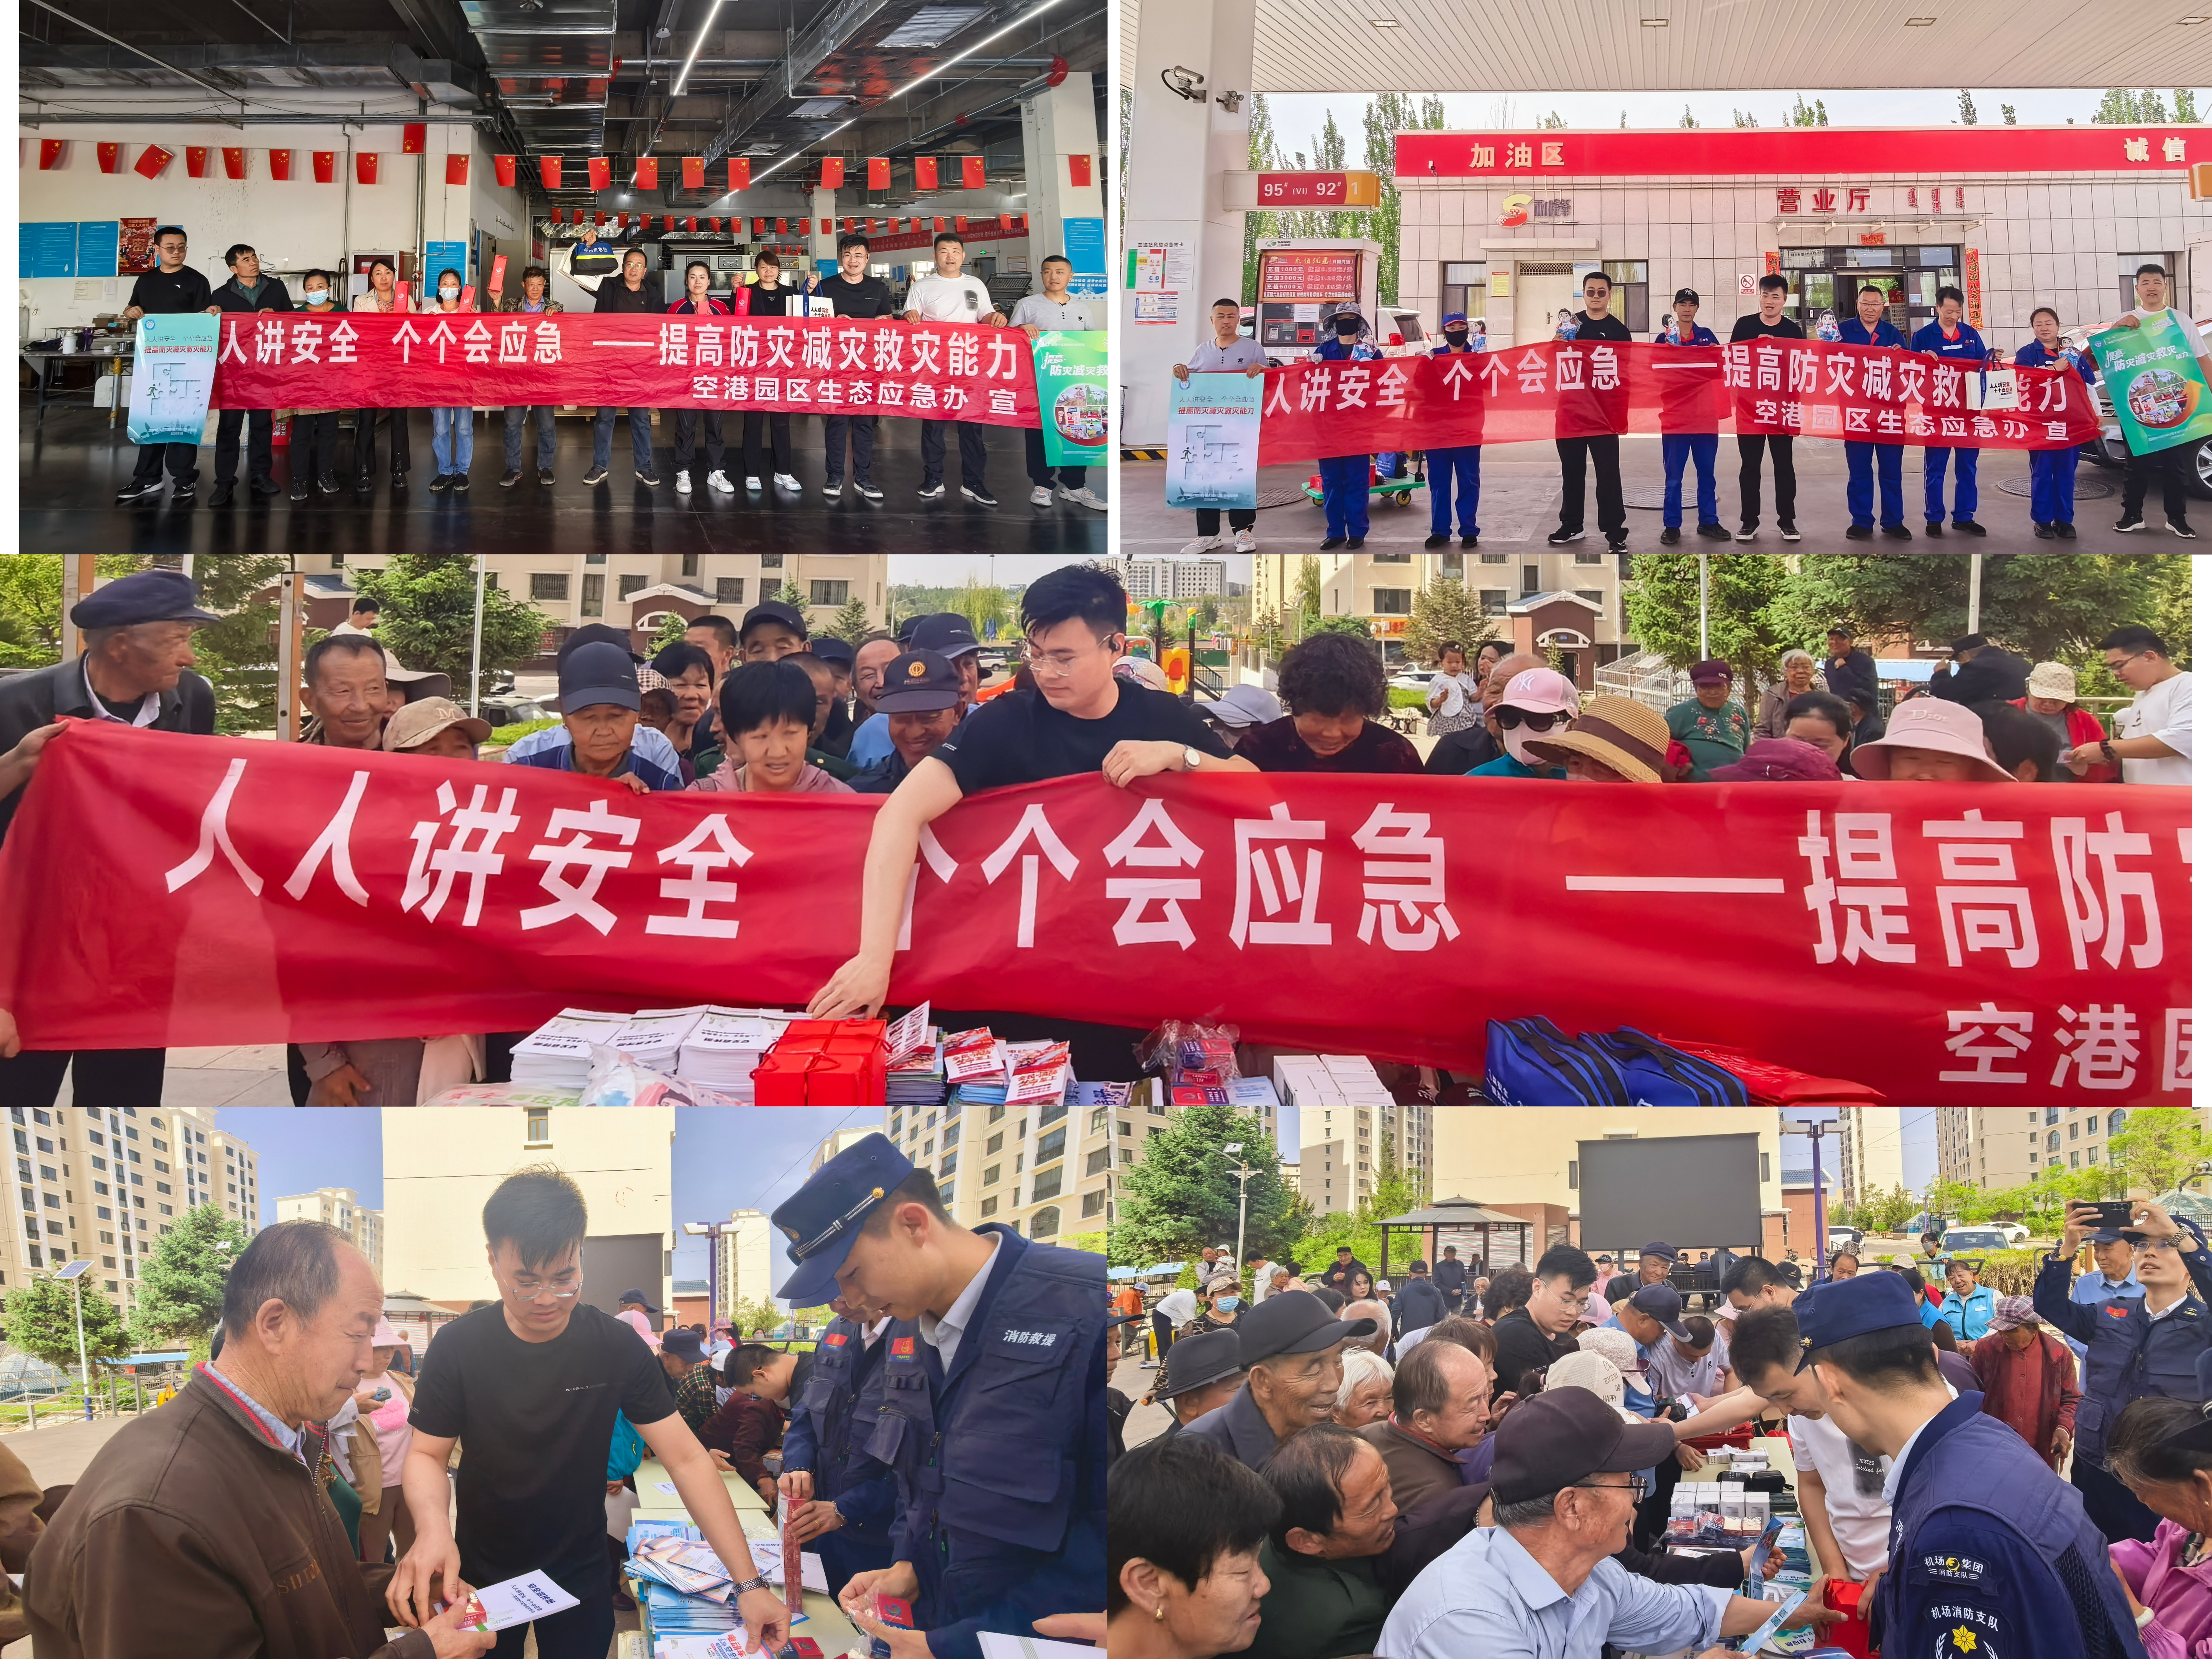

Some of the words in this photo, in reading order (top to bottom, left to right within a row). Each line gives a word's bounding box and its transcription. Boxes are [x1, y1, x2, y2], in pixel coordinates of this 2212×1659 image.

[1469, 142, 1564, 168] 加油区
[2124, 137, 2186, 162] 诚信
[1351, 182, 1358, 195] 1
[1777, 187, 1871, 213] 营业厅
[392, 319, 562, 364] 个个会应急
[1041, 352, 1067, 369] 提高
[2105, 349, 2126, 368] 提高
[2114, 346, 2177, 372] 防灾减灾救灾
[1443, 345, 1621, 401] 个个会应急
[693, 375, 969, 410] 空港园区生态应急办
[989, 389, 1018, 416] 宣
[1178, 407, 1254, 415] 提高防灾减灾救灾能力
[1754, 399, 2028, 439] 空港园区生态应急办
[165, 758, 754, 939] 人人讲安全
[1003, 1330, 1057, 1346] 消防救援
[1604, 1372, 1618, 1384] EVERY
[1925, 1556, 1945, 1567] 机场
[1961, 1558, 1983, 1574] 集团
[1939, 1569, 1968, 1579] 消防支队
[511, 1585, 527, 1598] 人人讲安全
[526, 1599, 543, 1611] 个个会应急
[528, 1583, 556, 1604] 安全宣传册
[1931, 1605, 1998, 1631] 机场消防支队
[727, 1634, 747, 1657] 电动车
